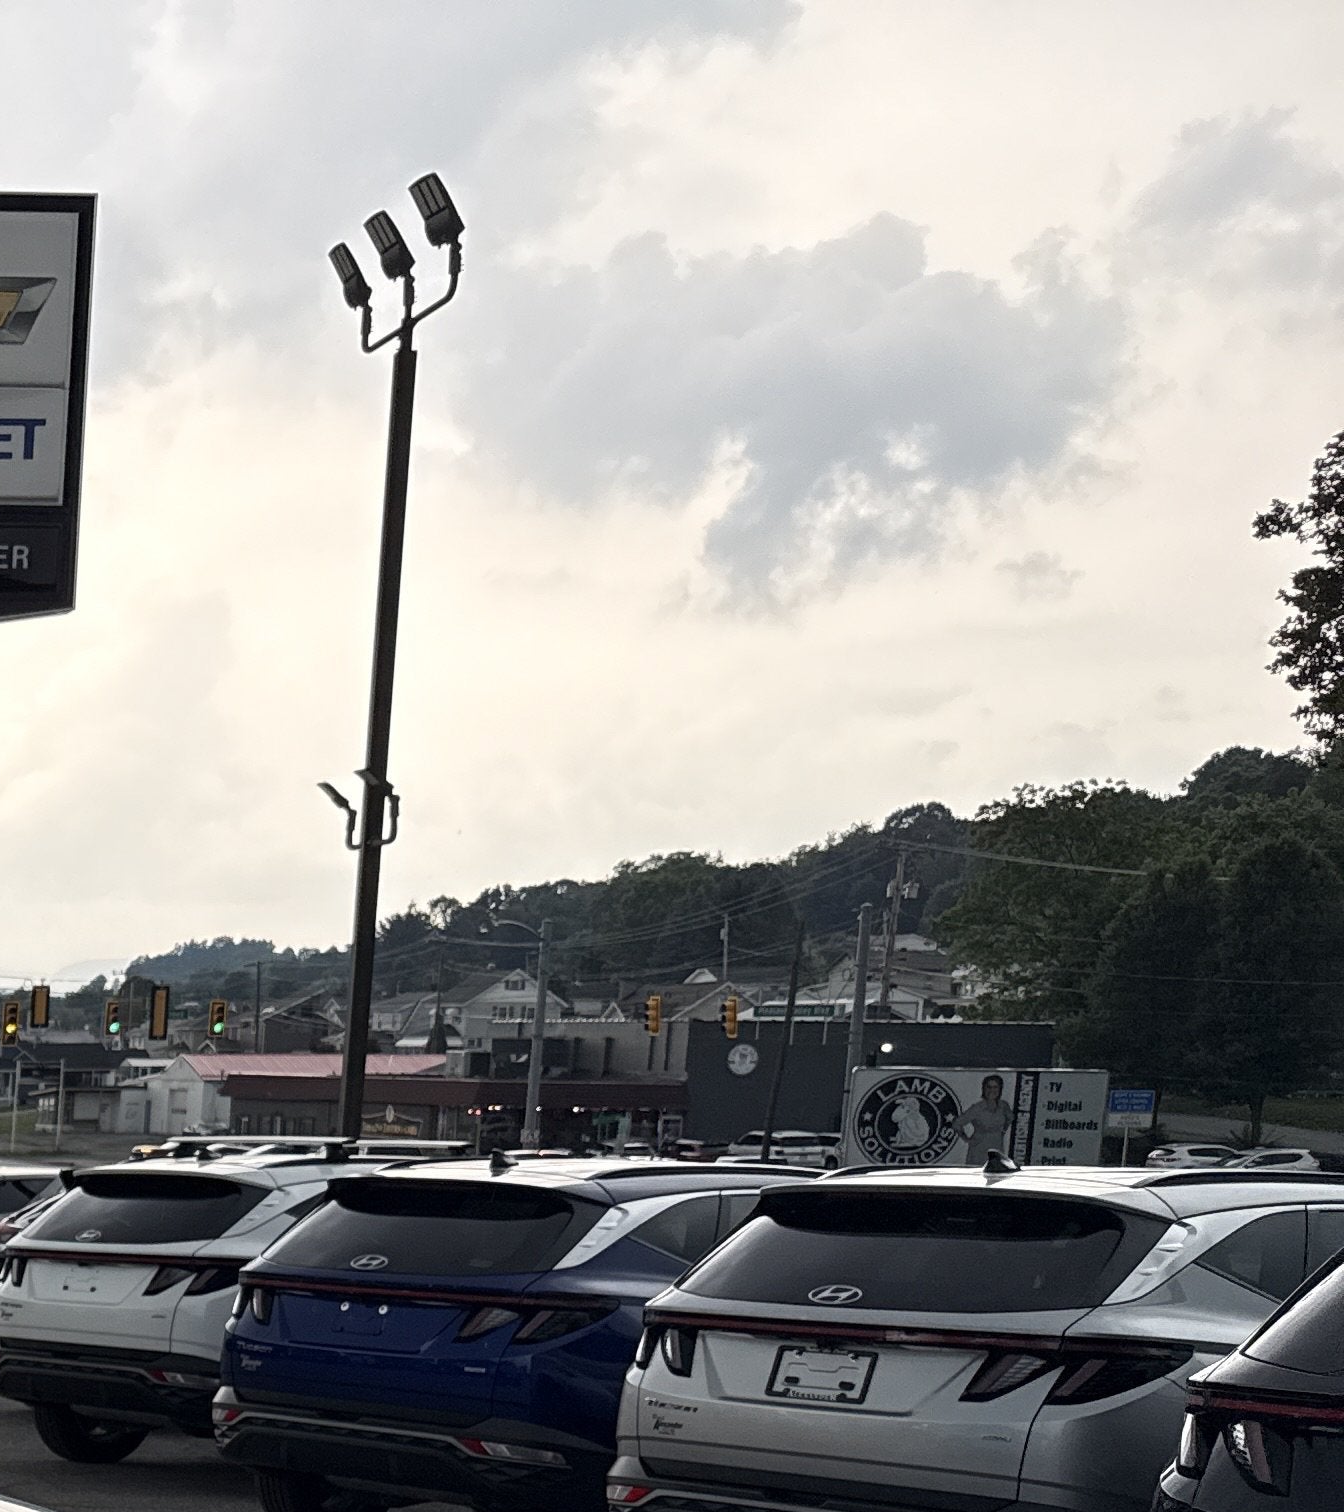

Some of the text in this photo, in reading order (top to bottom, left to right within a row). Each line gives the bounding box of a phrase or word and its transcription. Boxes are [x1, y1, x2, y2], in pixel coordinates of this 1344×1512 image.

[876, 1078, 947, 1104] LAMB
[1048, 1081, 1063, 1093] TV
[1046, 1100, 1083, 1113] Digital
[1044, 1118, 1099, 1131] Billboards
[859, 1125, 955, 1166] SOLUTIONS
[1042, 1137, 1074, 1149] Radio
[1040, 1155, 1067, 1166] Print
